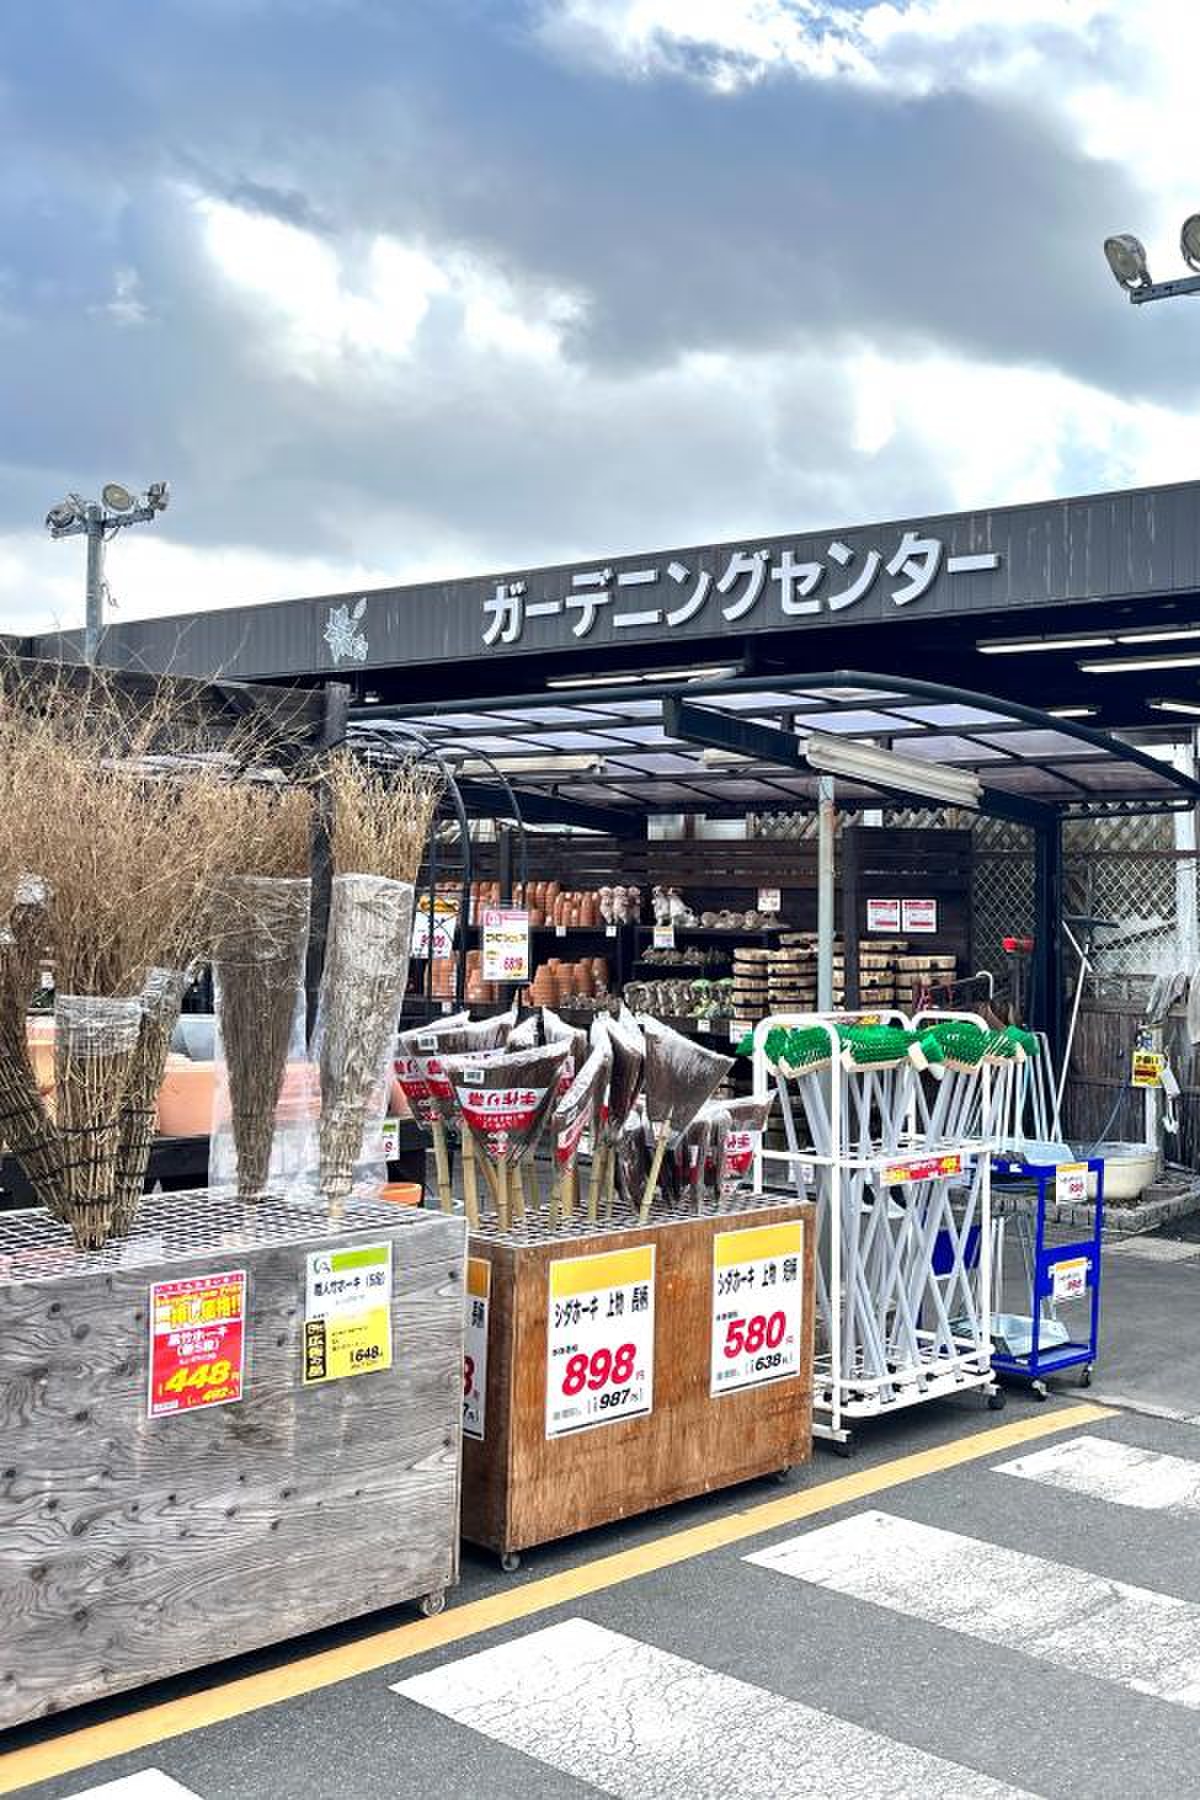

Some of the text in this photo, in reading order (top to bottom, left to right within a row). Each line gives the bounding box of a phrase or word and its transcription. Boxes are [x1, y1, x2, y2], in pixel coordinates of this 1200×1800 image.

[482, 531, 999, 646] ガーデニングセンター
[724, 1311, 787, 1358] 580
[165, 1360, 231, 1393] 448
[562, 1343, 637, 1396] 898
[755, 1353, 781, 1371] 638
[599, 1388, 631, 1409] 987
